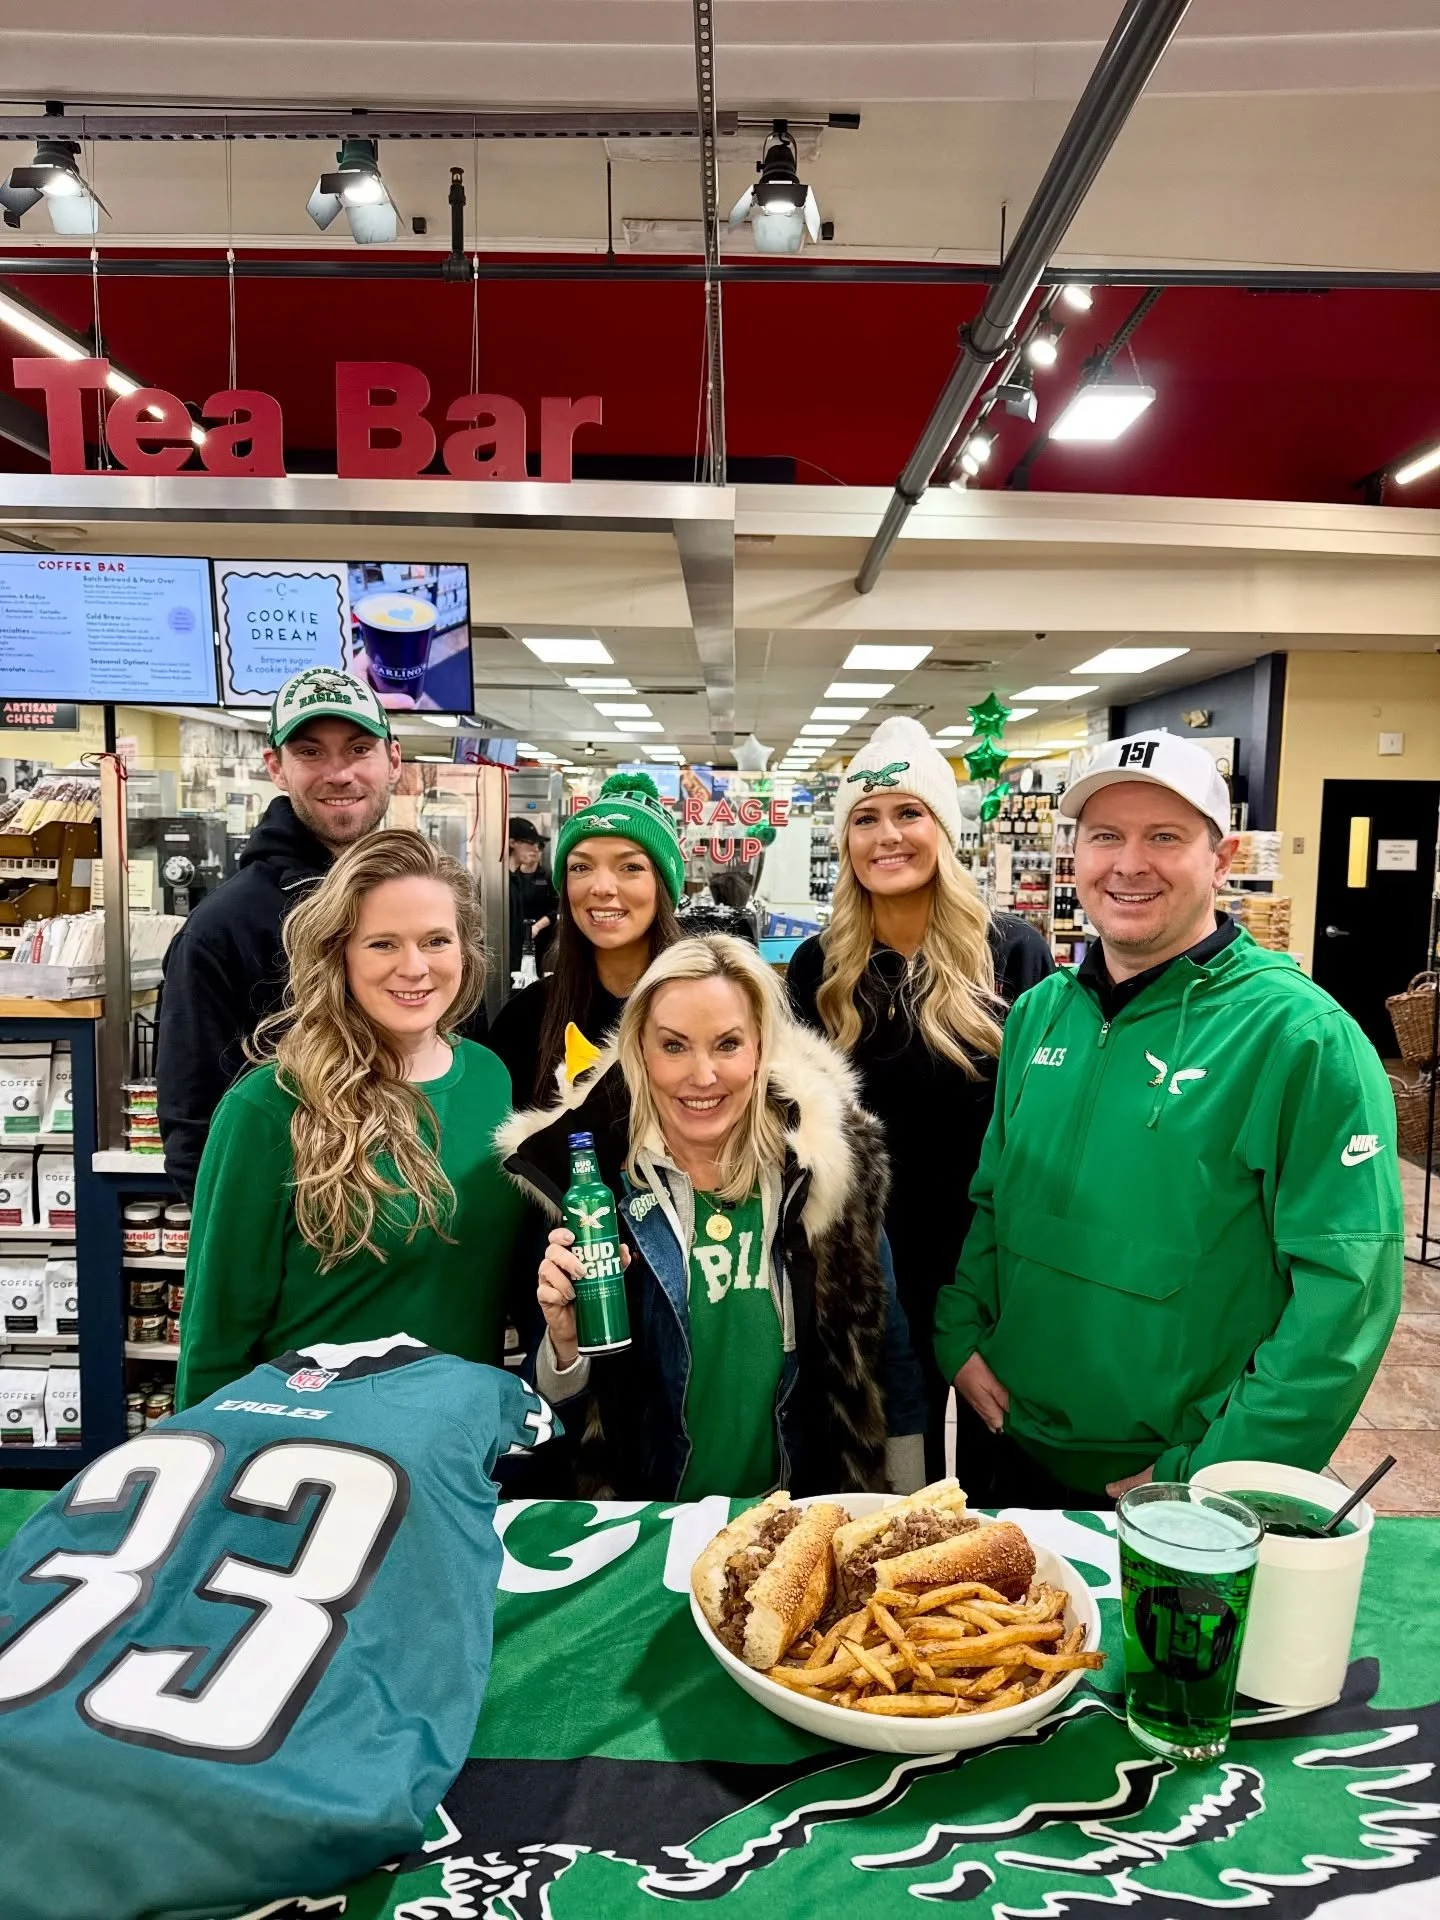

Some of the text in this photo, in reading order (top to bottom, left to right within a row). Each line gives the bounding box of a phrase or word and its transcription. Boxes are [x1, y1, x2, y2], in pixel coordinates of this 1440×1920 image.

[13, 358, 602, 483] Tea Bar
[38, 560, 125, 572] COFFEE BAR
[86, 612, 102, 620] Cold
[246, 609, 319, 625] COOKIE
[251, 628, 318, 641] DREAM
[261, 656, 313, 665] brown sugar
[246, 665, 253, 673] &
[255, 665, 282, 673] cookie
[299, 691, 352, 709] EAGLES
[3, 702, 58, 714] ARTISAN
[6, 713, 55, 725] CHEESE
[1031, 1046, 1068, 1067] AGLES
[0, 1079, 43, 1087] COFFEE
[1348, 1134, 1379, 1153] NIKE
[572, 1165, 597, 1174] LIGHT
[574, 1159, 592, 1168] BUD
[123, 1231, 156, 1240] nutella
[164, 1233, 189, 1241] nutell
[571, 1241, 615, 1262] BUD
[571, 1256, 621, 1281] GHT
[0, 1279, 41, 1287] COFFEE
[293, 1375, 327, 1387] NFL
[0, 1392, 37, 1401] OFFEE
[52, 1391, 78, 1399] COFF
[213, 1399, 334, 1421] EAGLES
[0, 1430, 410, 1764] 33
